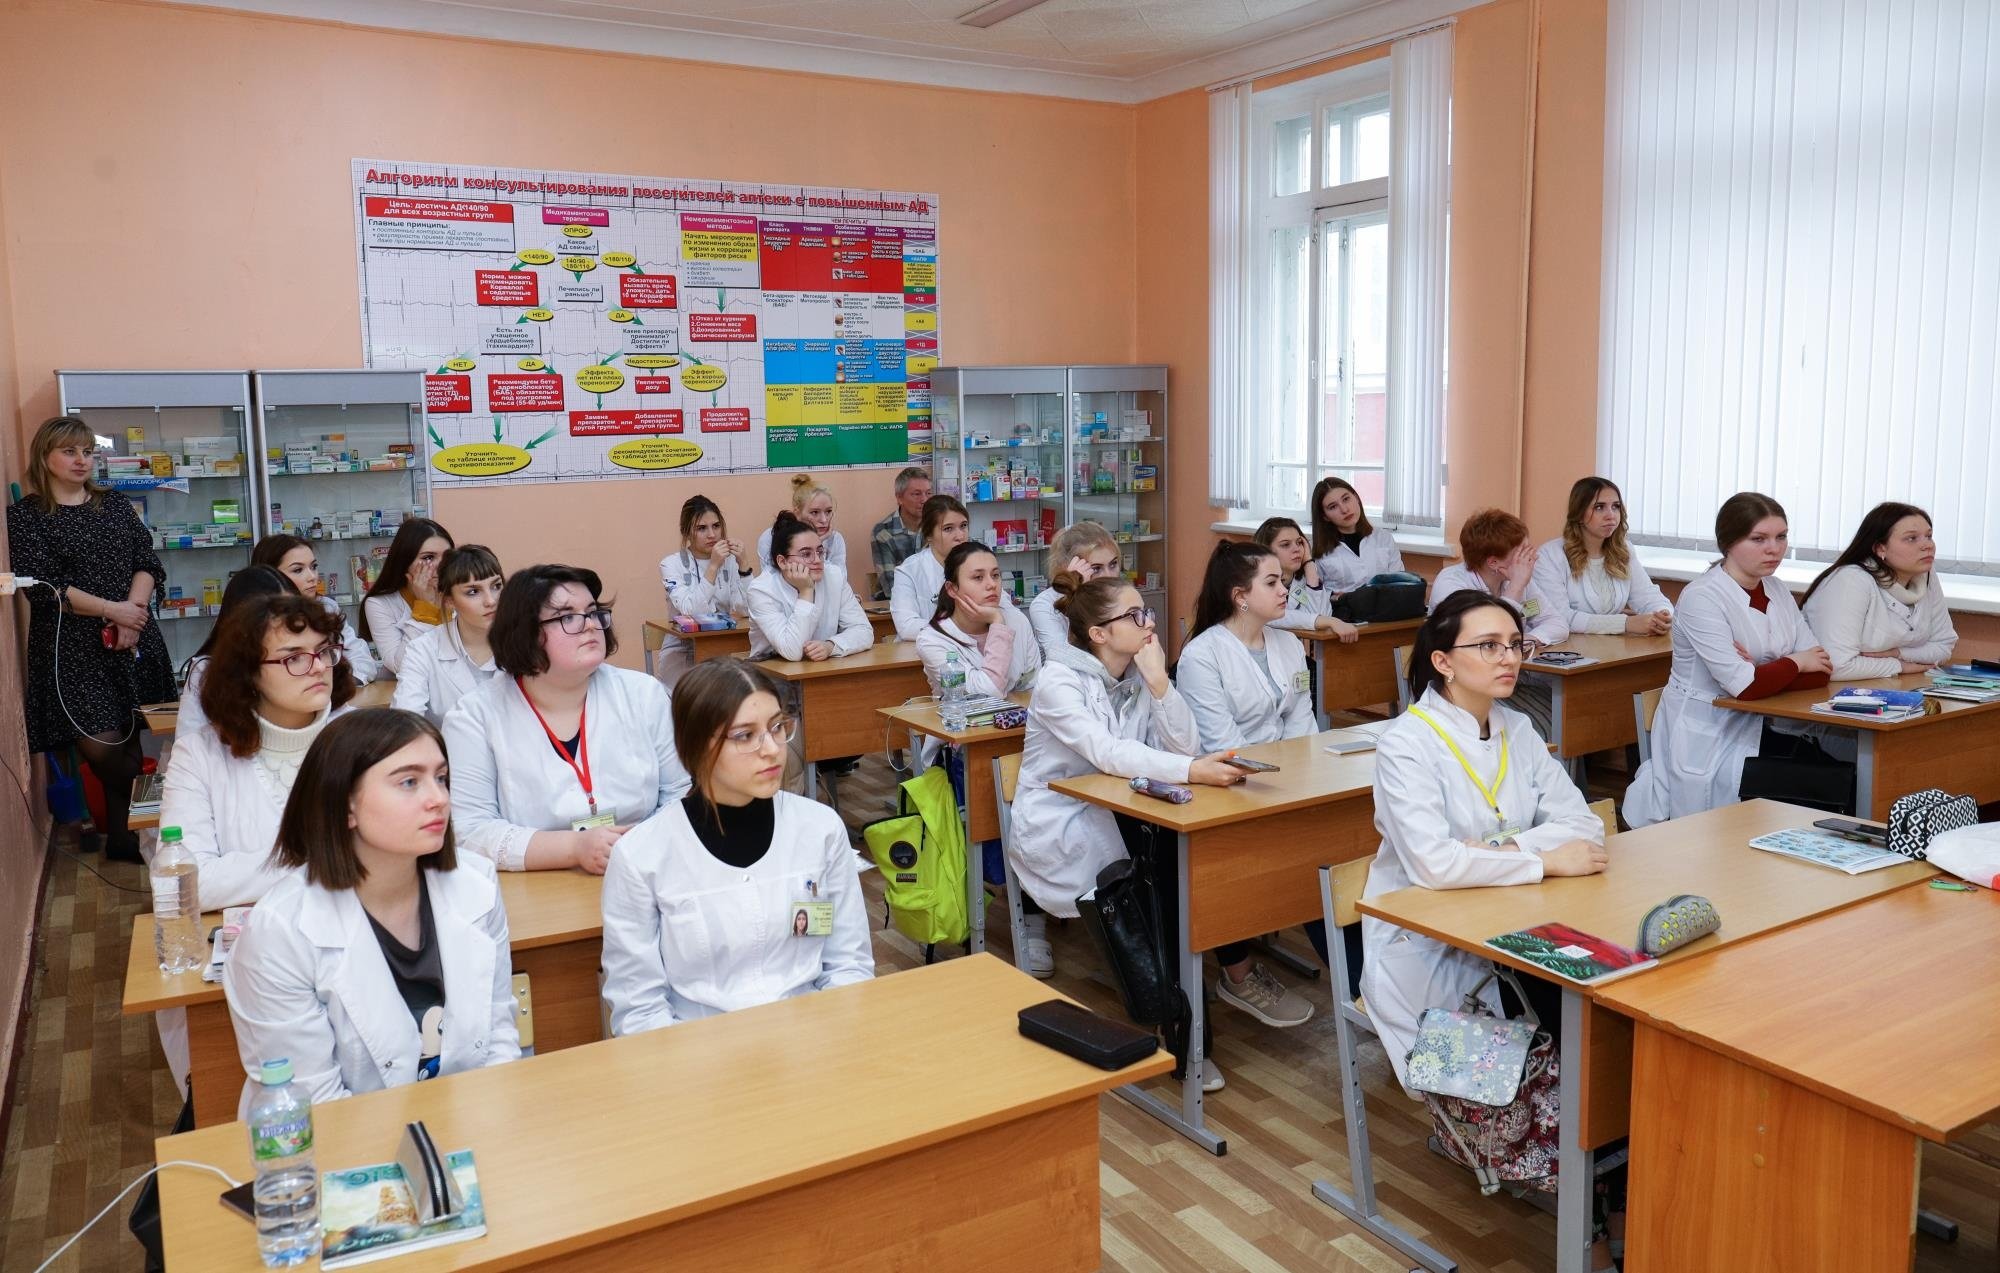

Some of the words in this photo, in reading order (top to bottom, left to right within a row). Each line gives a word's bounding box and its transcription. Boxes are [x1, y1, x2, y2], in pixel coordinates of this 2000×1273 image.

[366, 168, 459, 189] Алгоритм
[463, 177, 628, 197] консультирования
[632, 187, 735, 203] посетителей
[738, 192, 791, 206] аптеки
[795, 196, 805, 207] с
[808, 197, 906, 211] повышенным
[908, 200, 930, 214] АД
[389, 200, 413, 209] Цель:
[450, 204, 489, 212] АД<140/90
[422, 210, 470, 218] возрастных
[546, 208, 605, 217] Медикаментозная
[368, 219, 404, 227] Главные
[684, 216, 754, 225] Немедикаментозные
[684, 232, 709, 240] Начать
